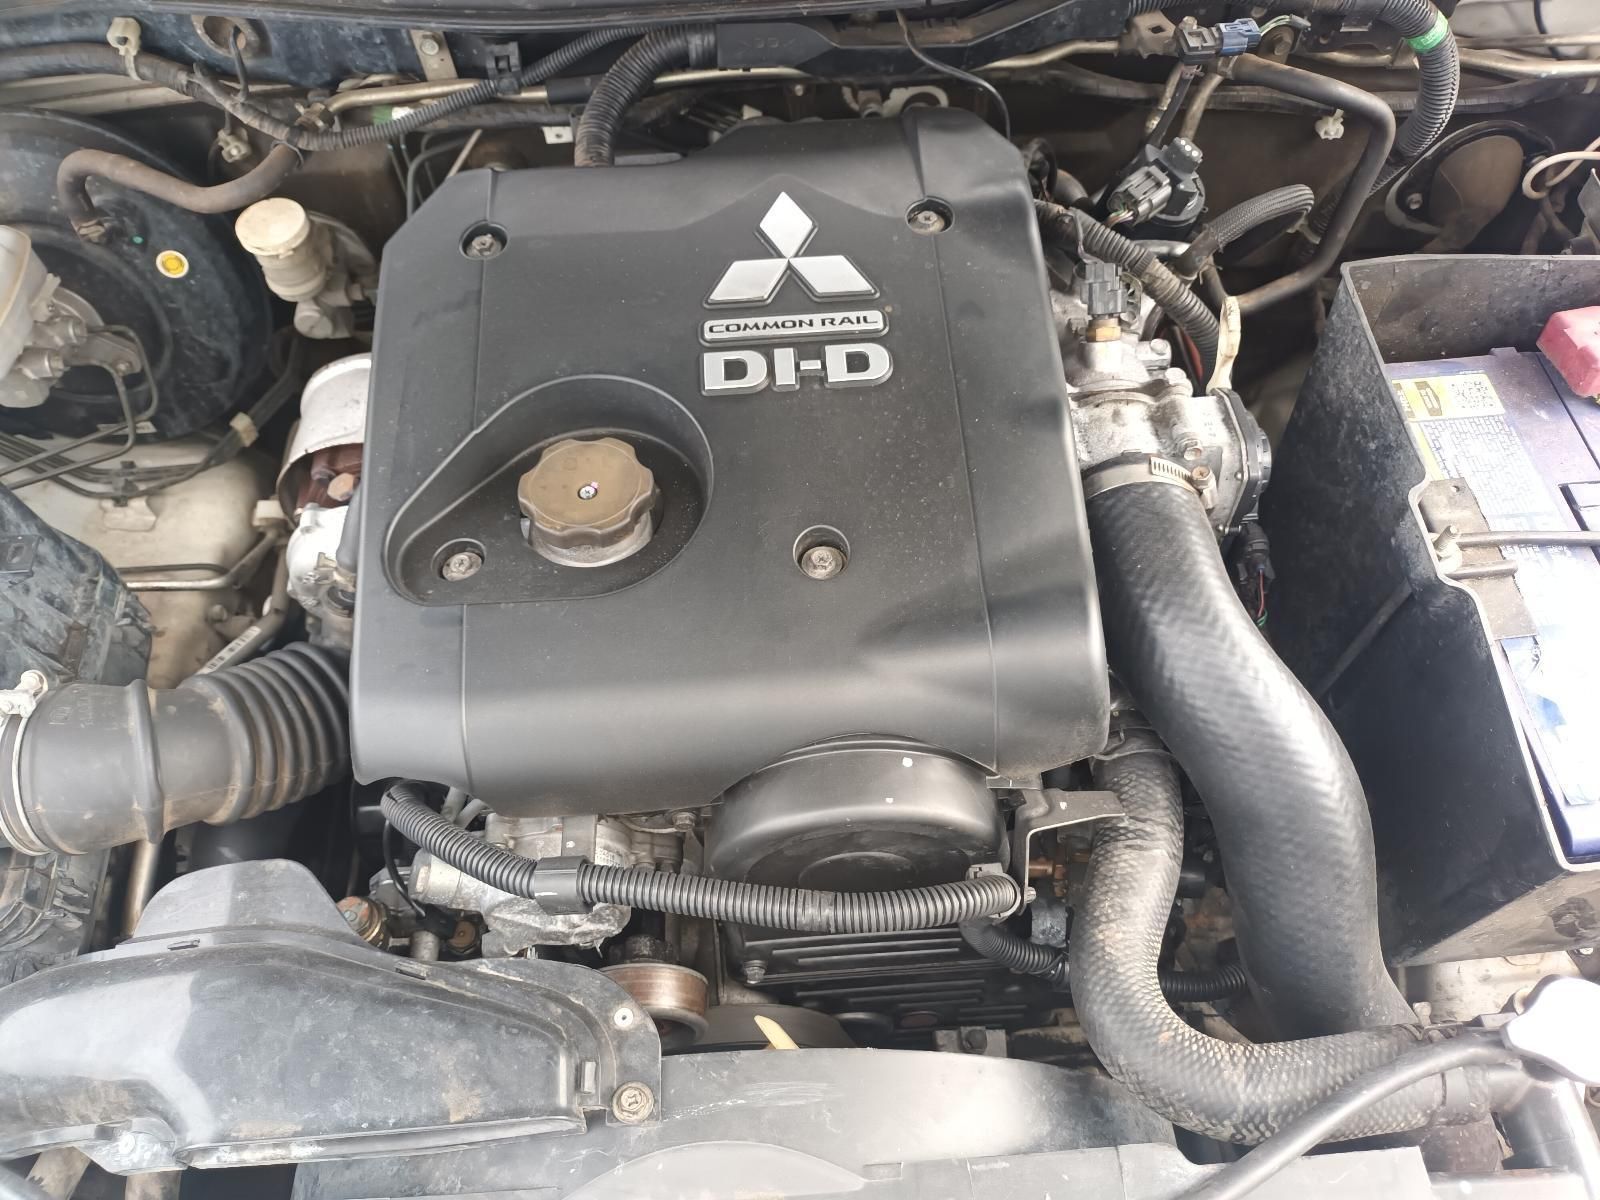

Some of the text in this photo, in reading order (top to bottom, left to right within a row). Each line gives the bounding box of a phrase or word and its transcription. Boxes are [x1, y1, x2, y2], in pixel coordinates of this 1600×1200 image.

[708, 315, 878, 334] COMMON RAIL
[702, 342, 892, 393] DI-D
